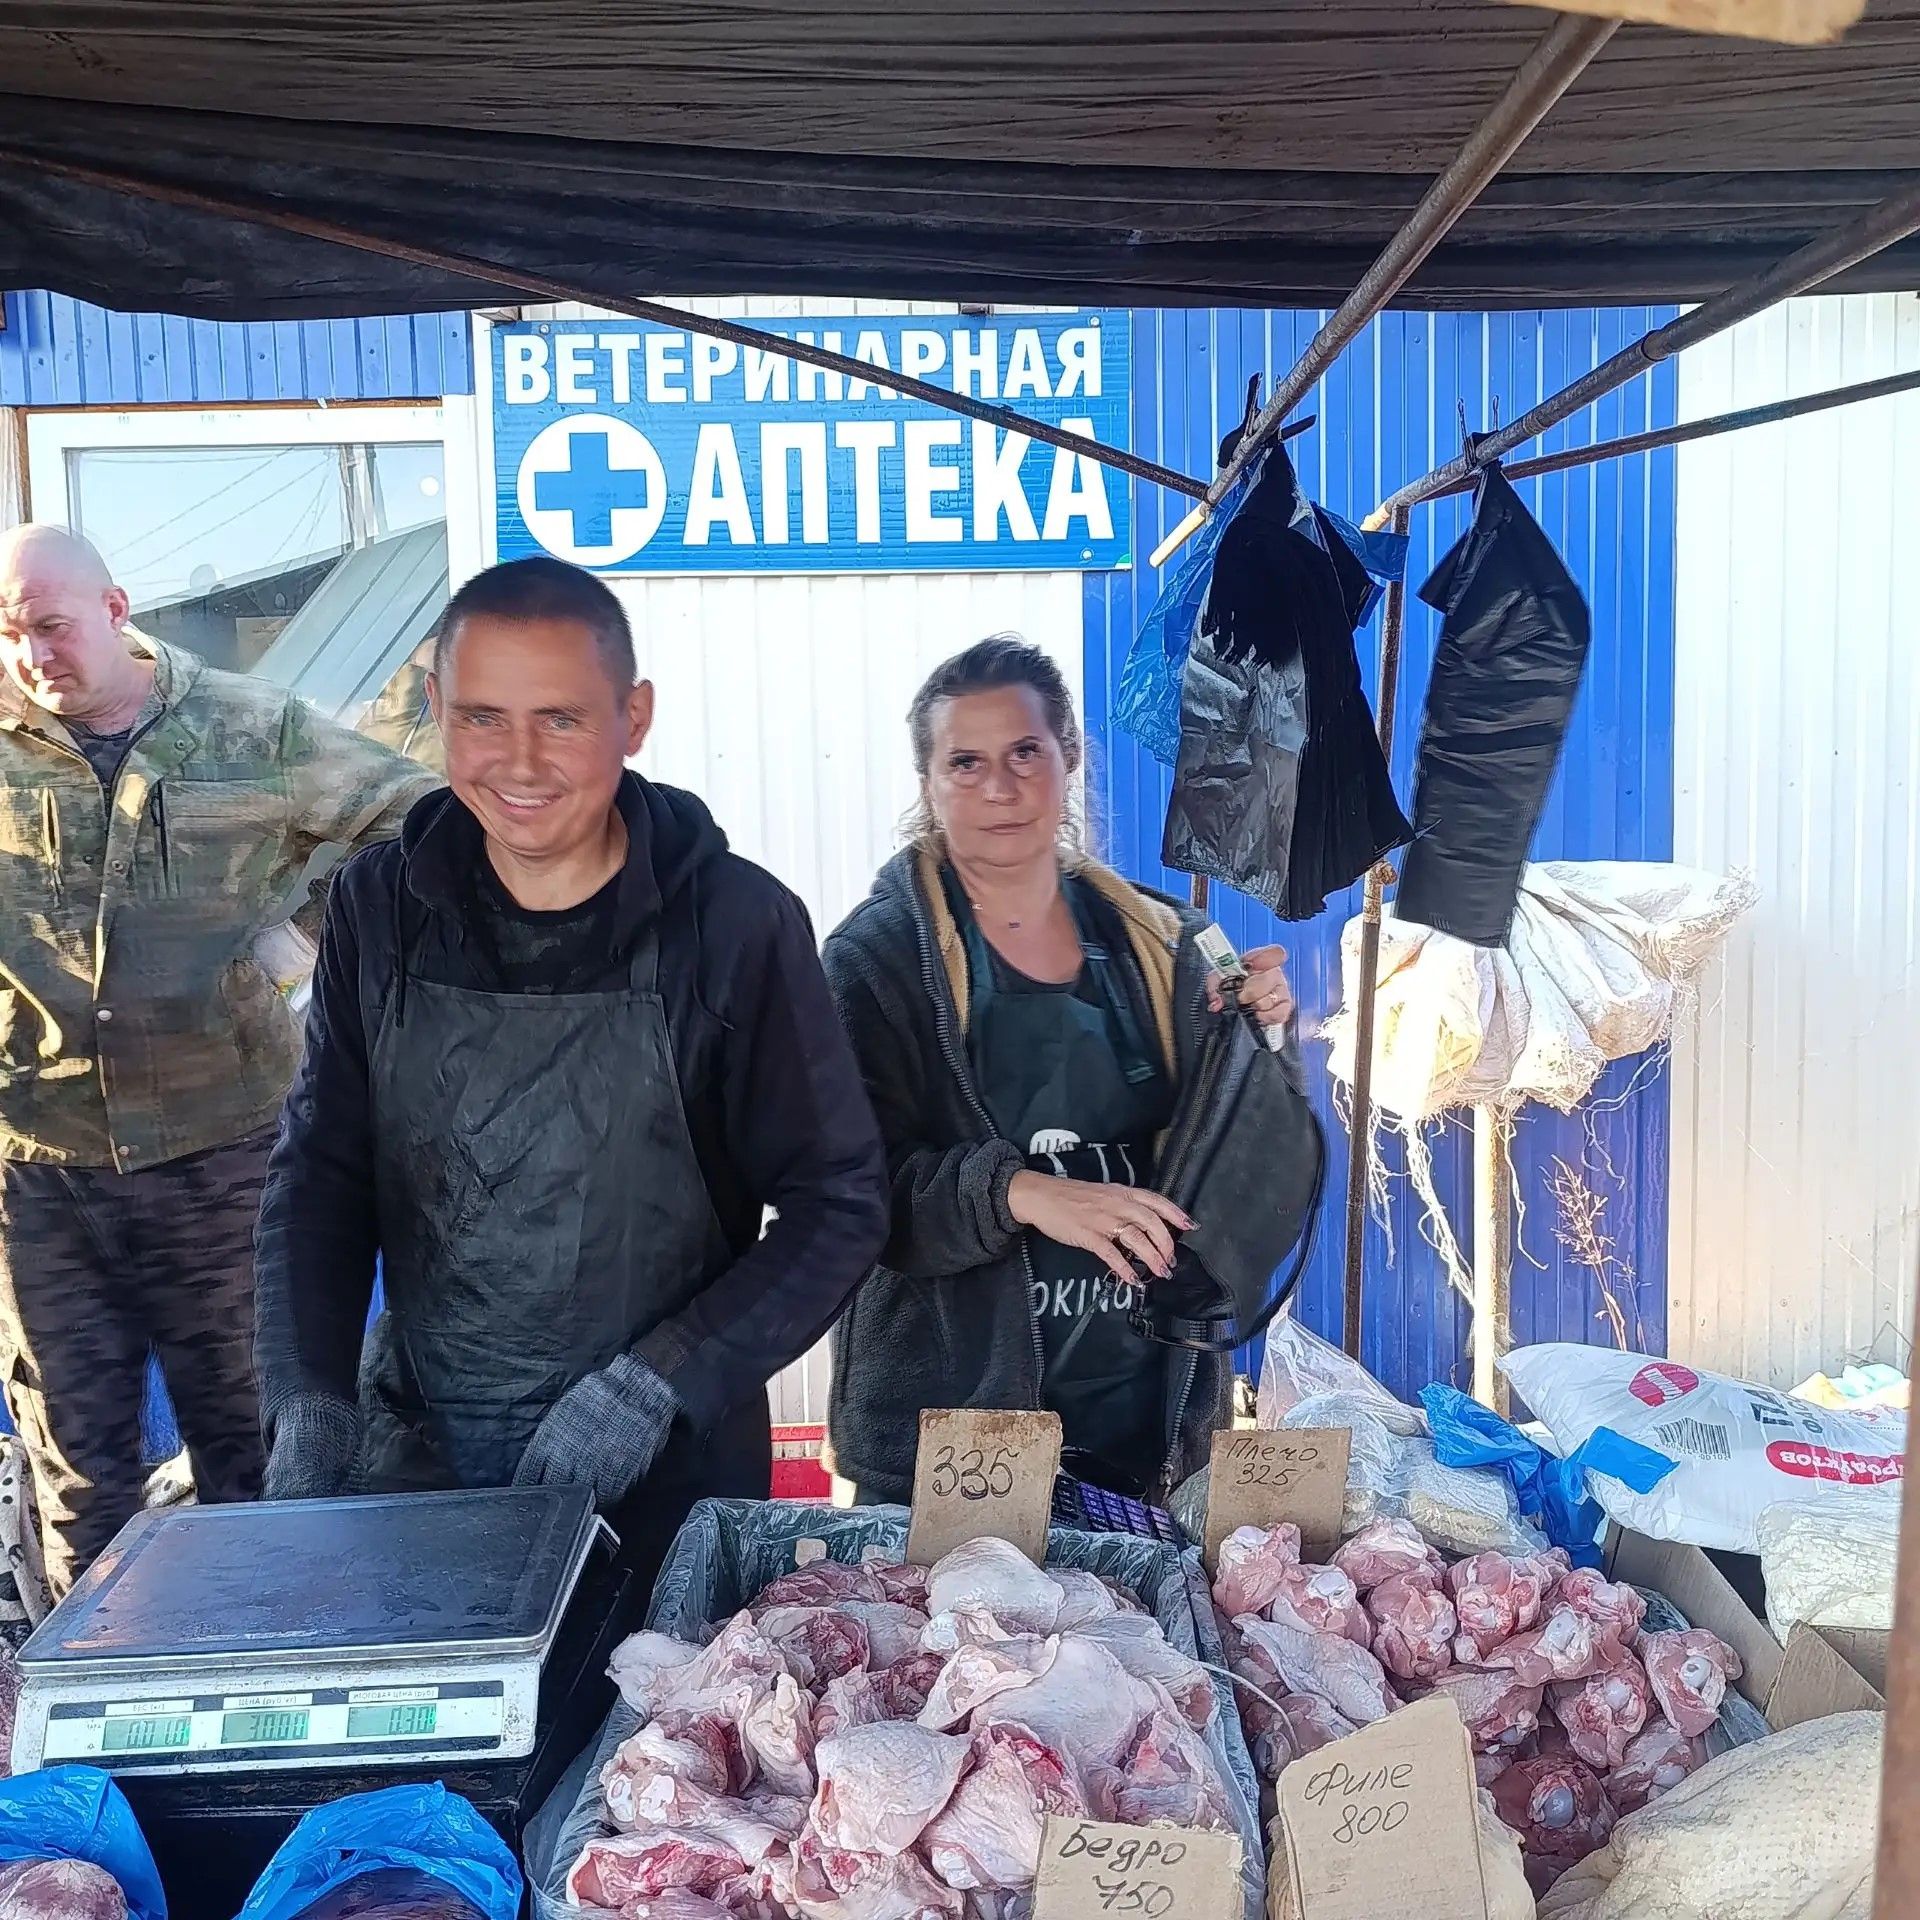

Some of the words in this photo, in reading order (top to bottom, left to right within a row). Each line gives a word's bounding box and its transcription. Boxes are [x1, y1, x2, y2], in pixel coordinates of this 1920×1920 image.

[503, 327, 1103, 405] ВЕТЕРИНАРНАЯ
[682, 416, 1116, 546] АПТЕКА
[1226, 1436, 1319, 1462] Плечо
[932, 1445, 1020, 1500] 335
[1235, 1462, 1299, 1486] 325
[1304, 1760, 1413, 1806] Филе
[1332, 1801, 1409, 1844] 800
[1057, 1823, 1187, 1872] Бедро
[1092, 1875, 1175, 1919] 750
